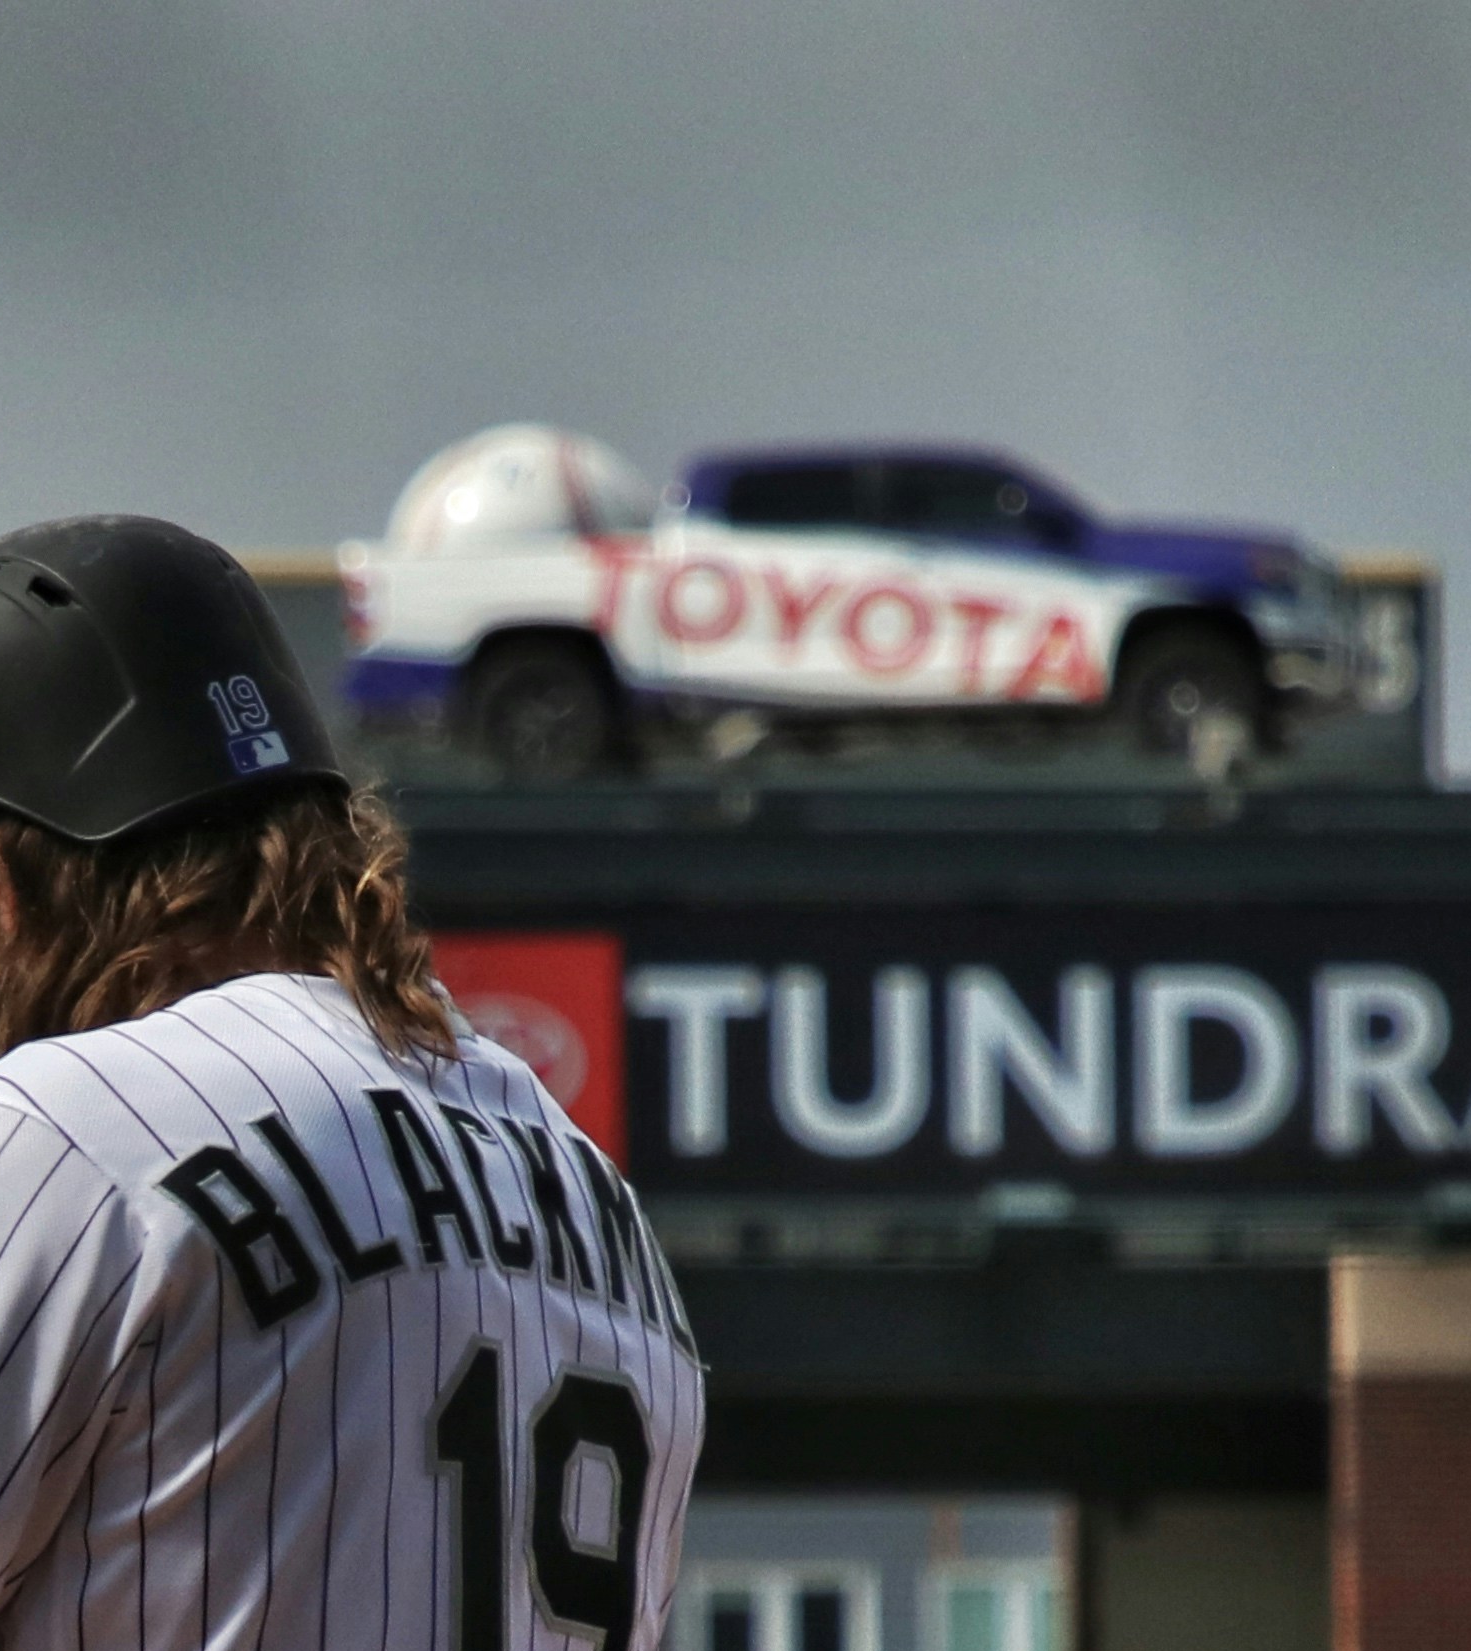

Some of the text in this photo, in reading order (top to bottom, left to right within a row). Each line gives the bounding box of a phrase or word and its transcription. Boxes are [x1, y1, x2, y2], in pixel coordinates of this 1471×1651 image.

[581, 532, 1111, 704] TOYOTA
[207, 674, 270, 736] 19
[153, 1086, 699, 1366] BLACKM
